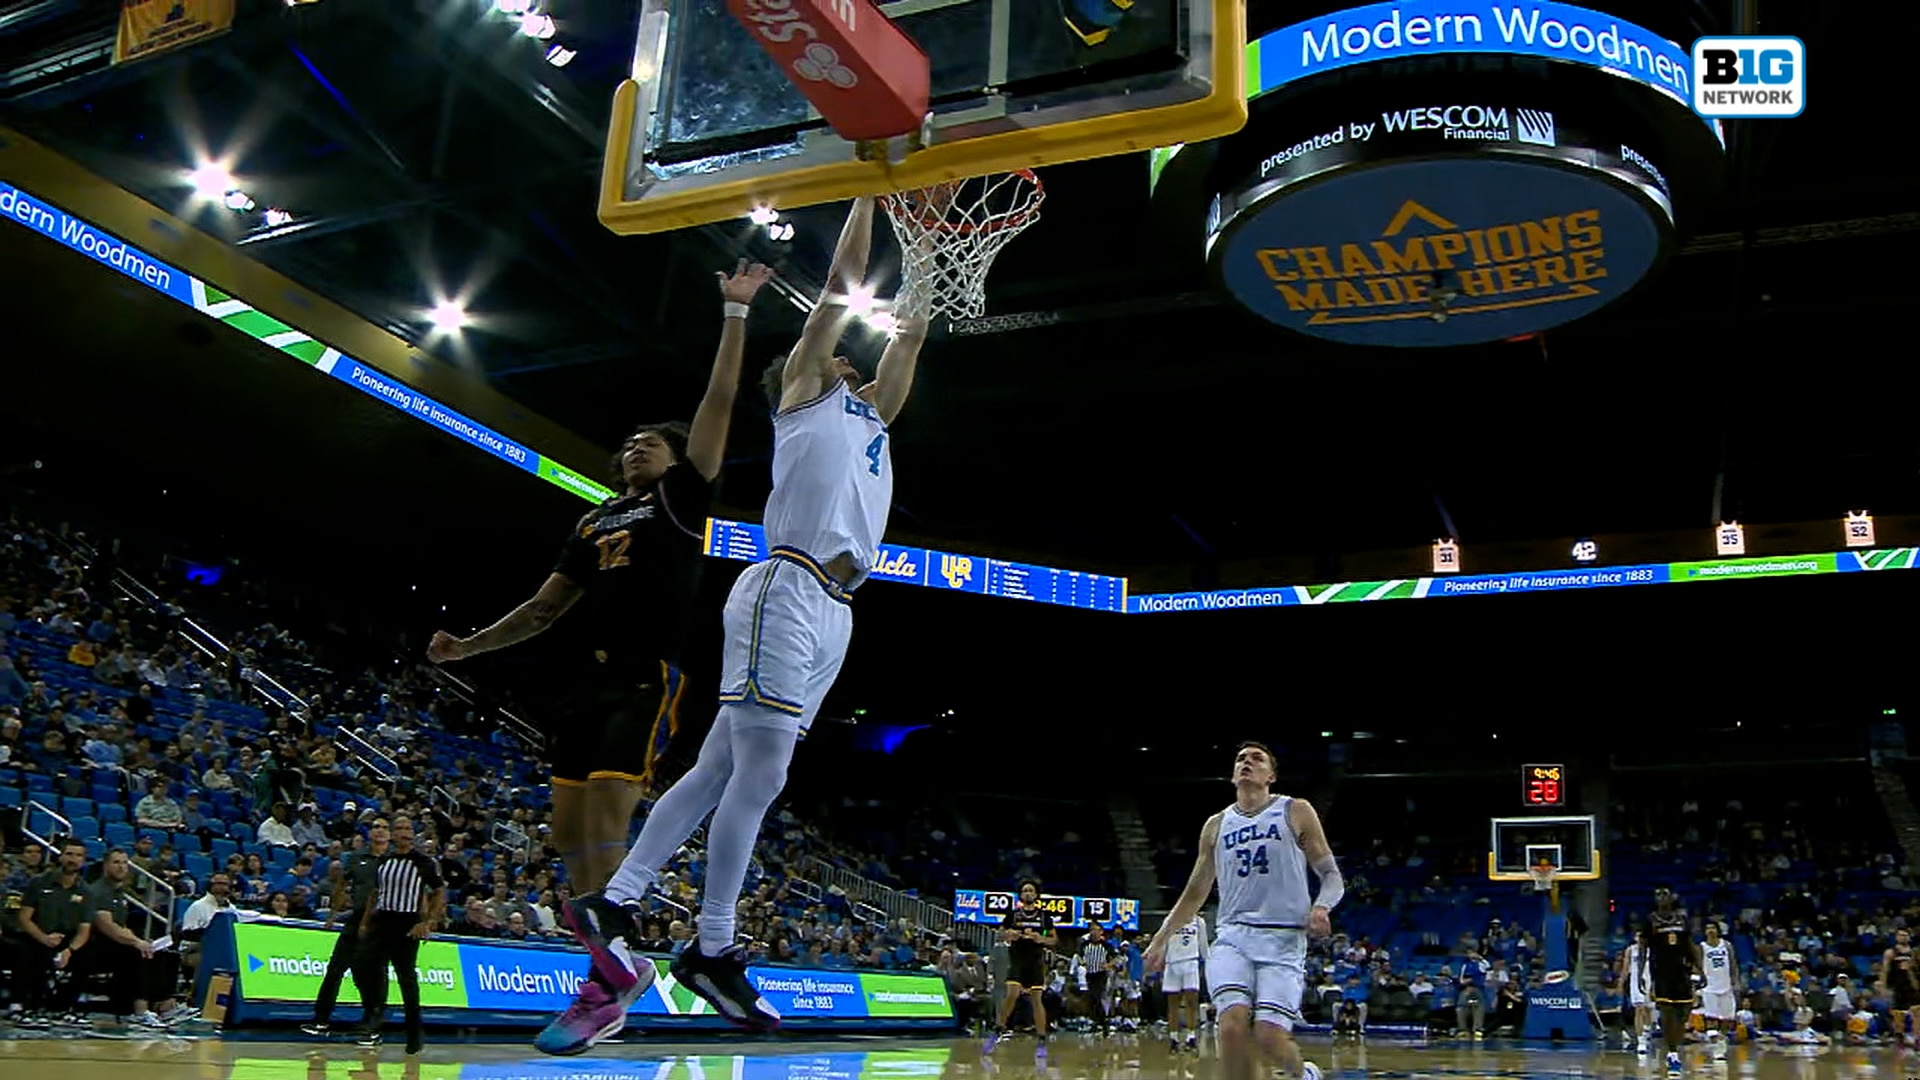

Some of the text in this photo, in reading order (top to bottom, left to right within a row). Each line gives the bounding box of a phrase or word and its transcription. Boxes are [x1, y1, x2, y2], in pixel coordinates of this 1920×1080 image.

[1300, 7, 1691, 95] Modern Woodmen
[1260, 105, 1509, 178] presented by WESCOM
[1444, 127, 1509, 141] Financial
[61, 214, 171, 289] Woodmen
[1256, 208, 1604, 284] CHAMPIONS
[1275, 248, 1608, 311] MADE HERE
[351, 366, 527, 463] Pioneering life insurance since 1883
[866, 433, 884, 476] 4
[1722, 534, 1739, 545] 35
[1852, 525, 1869, 537] 52
[595, 530, 630, 570] 12
[1571, 541, 1597, 561] 42
[1444, 569, 1655, 593] Pioneering life insurance since 1883
[1138, 592, 1283, 612] Modern Woodmen
[1530, 780, 1559, 803] 28
[1224, 823, 1282, 850] UCLA
[1236, 844, 1270, 878] 34
[988, 895, 1009, 909] 20
[477, 963, 555, 995] Modern
[756, 976, 803, 995] Pioneering
[793, 996, 814, 1009] since
